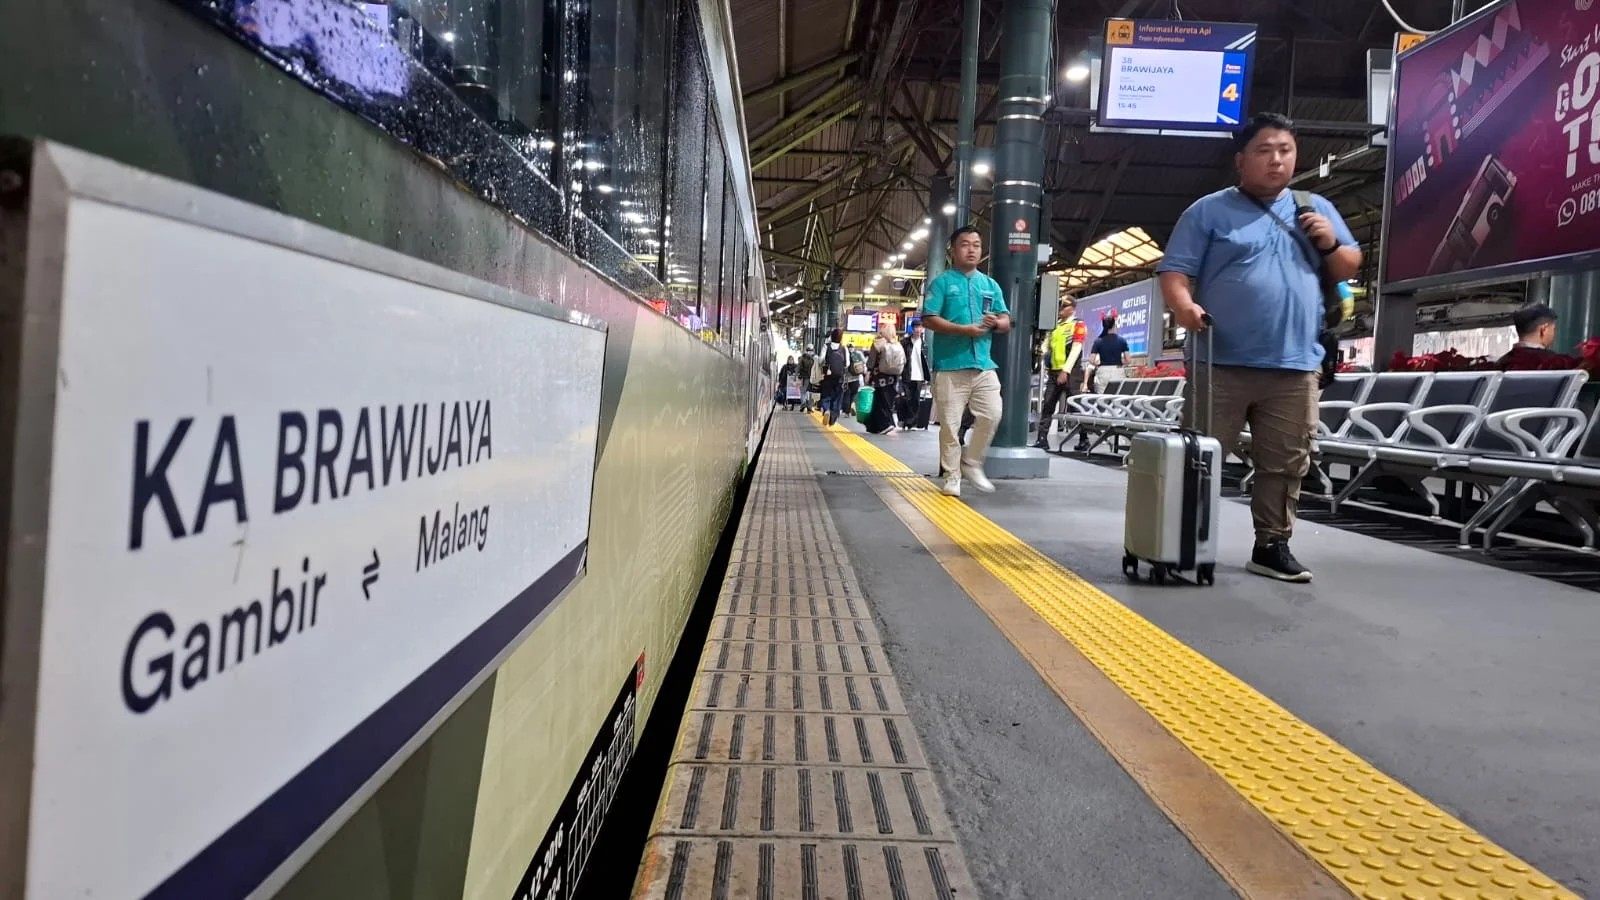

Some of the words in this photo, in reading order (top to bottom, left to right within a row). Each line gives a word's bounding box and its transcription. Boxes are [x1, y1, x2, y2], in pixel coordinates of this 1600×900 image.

[1138, 24, 1173, 33] Informasi
[1174, 26, 1198, 34] Kereta
[1199, 27, 1212, 36] Api
[1120, 65, 1175, 74] BRAWIJAYA
[1119, 84, 1156, 93] MALANG
[1222, 83, 1239, 102] 4
[1571, 177, 1592, 192] MAKE
[1115, 309, 1147, 328] OF-HOME
[127, 415, 249, 551] KA
[273, 399, 493, 515] BRAWIJAYA
[121, 557, 327, 714] Gambir
[416, 503, 490, 573] Malang
